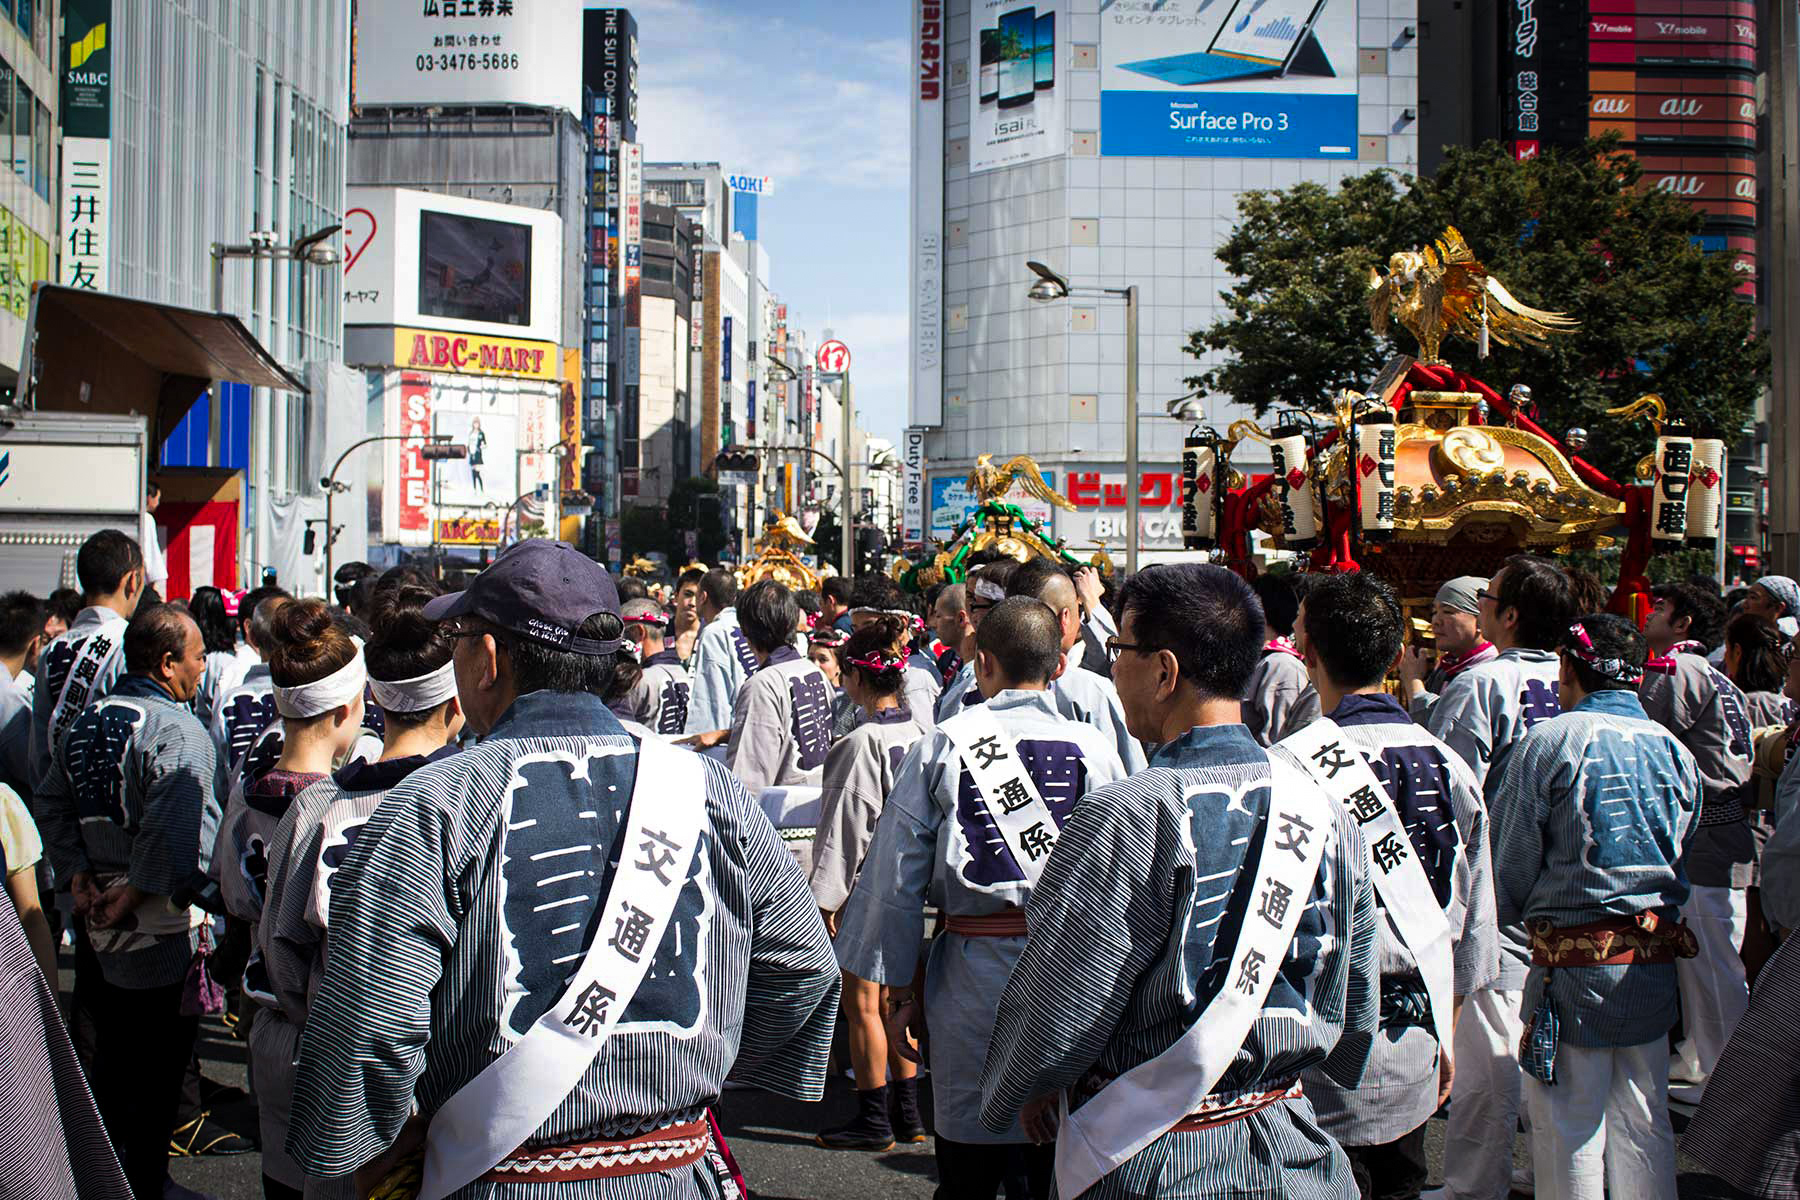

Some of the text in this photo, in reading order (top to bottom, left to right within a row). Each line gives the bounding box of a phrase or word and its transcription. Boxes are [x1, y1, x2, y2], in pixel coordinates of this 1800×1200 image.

[605, 9, 617, 35] THE
[1592, 22, 1633, 33] Y!mobile
[1656, 22, 1707, 35] Y!mobile
[433, 33, 501, 47] お問い合わせ
[604, 38, 617, 68] SUIT
[416, 53, 519, 71] 03-3476-5686
[67, 71, 108, 86] SMBC
[1517, 71, 1539, 131] 総合館
[1593, 98, 1631, 113] au
[1659, 98, 1704, 116] au
[994, 118, 1023, 136] isai
[1169, 111, 1289, 130] Surface Pro 3
[730, 176, 763, 192] AOKI
[69, 161, 100, 290] 三井住友
[409, 334, 545, 373] ABC-MART
[406, 394, 426, 507] SALE
[906, 434, 922, 470] Duty
[908, 473, 921, 504] Free
[969, 735, 1055, 862] 交通係
[1311, 741, 1408, 875] 交通係
[1235, 812, 1314, 996] 交通係
[563, 826, 682, 1037] 交通係
